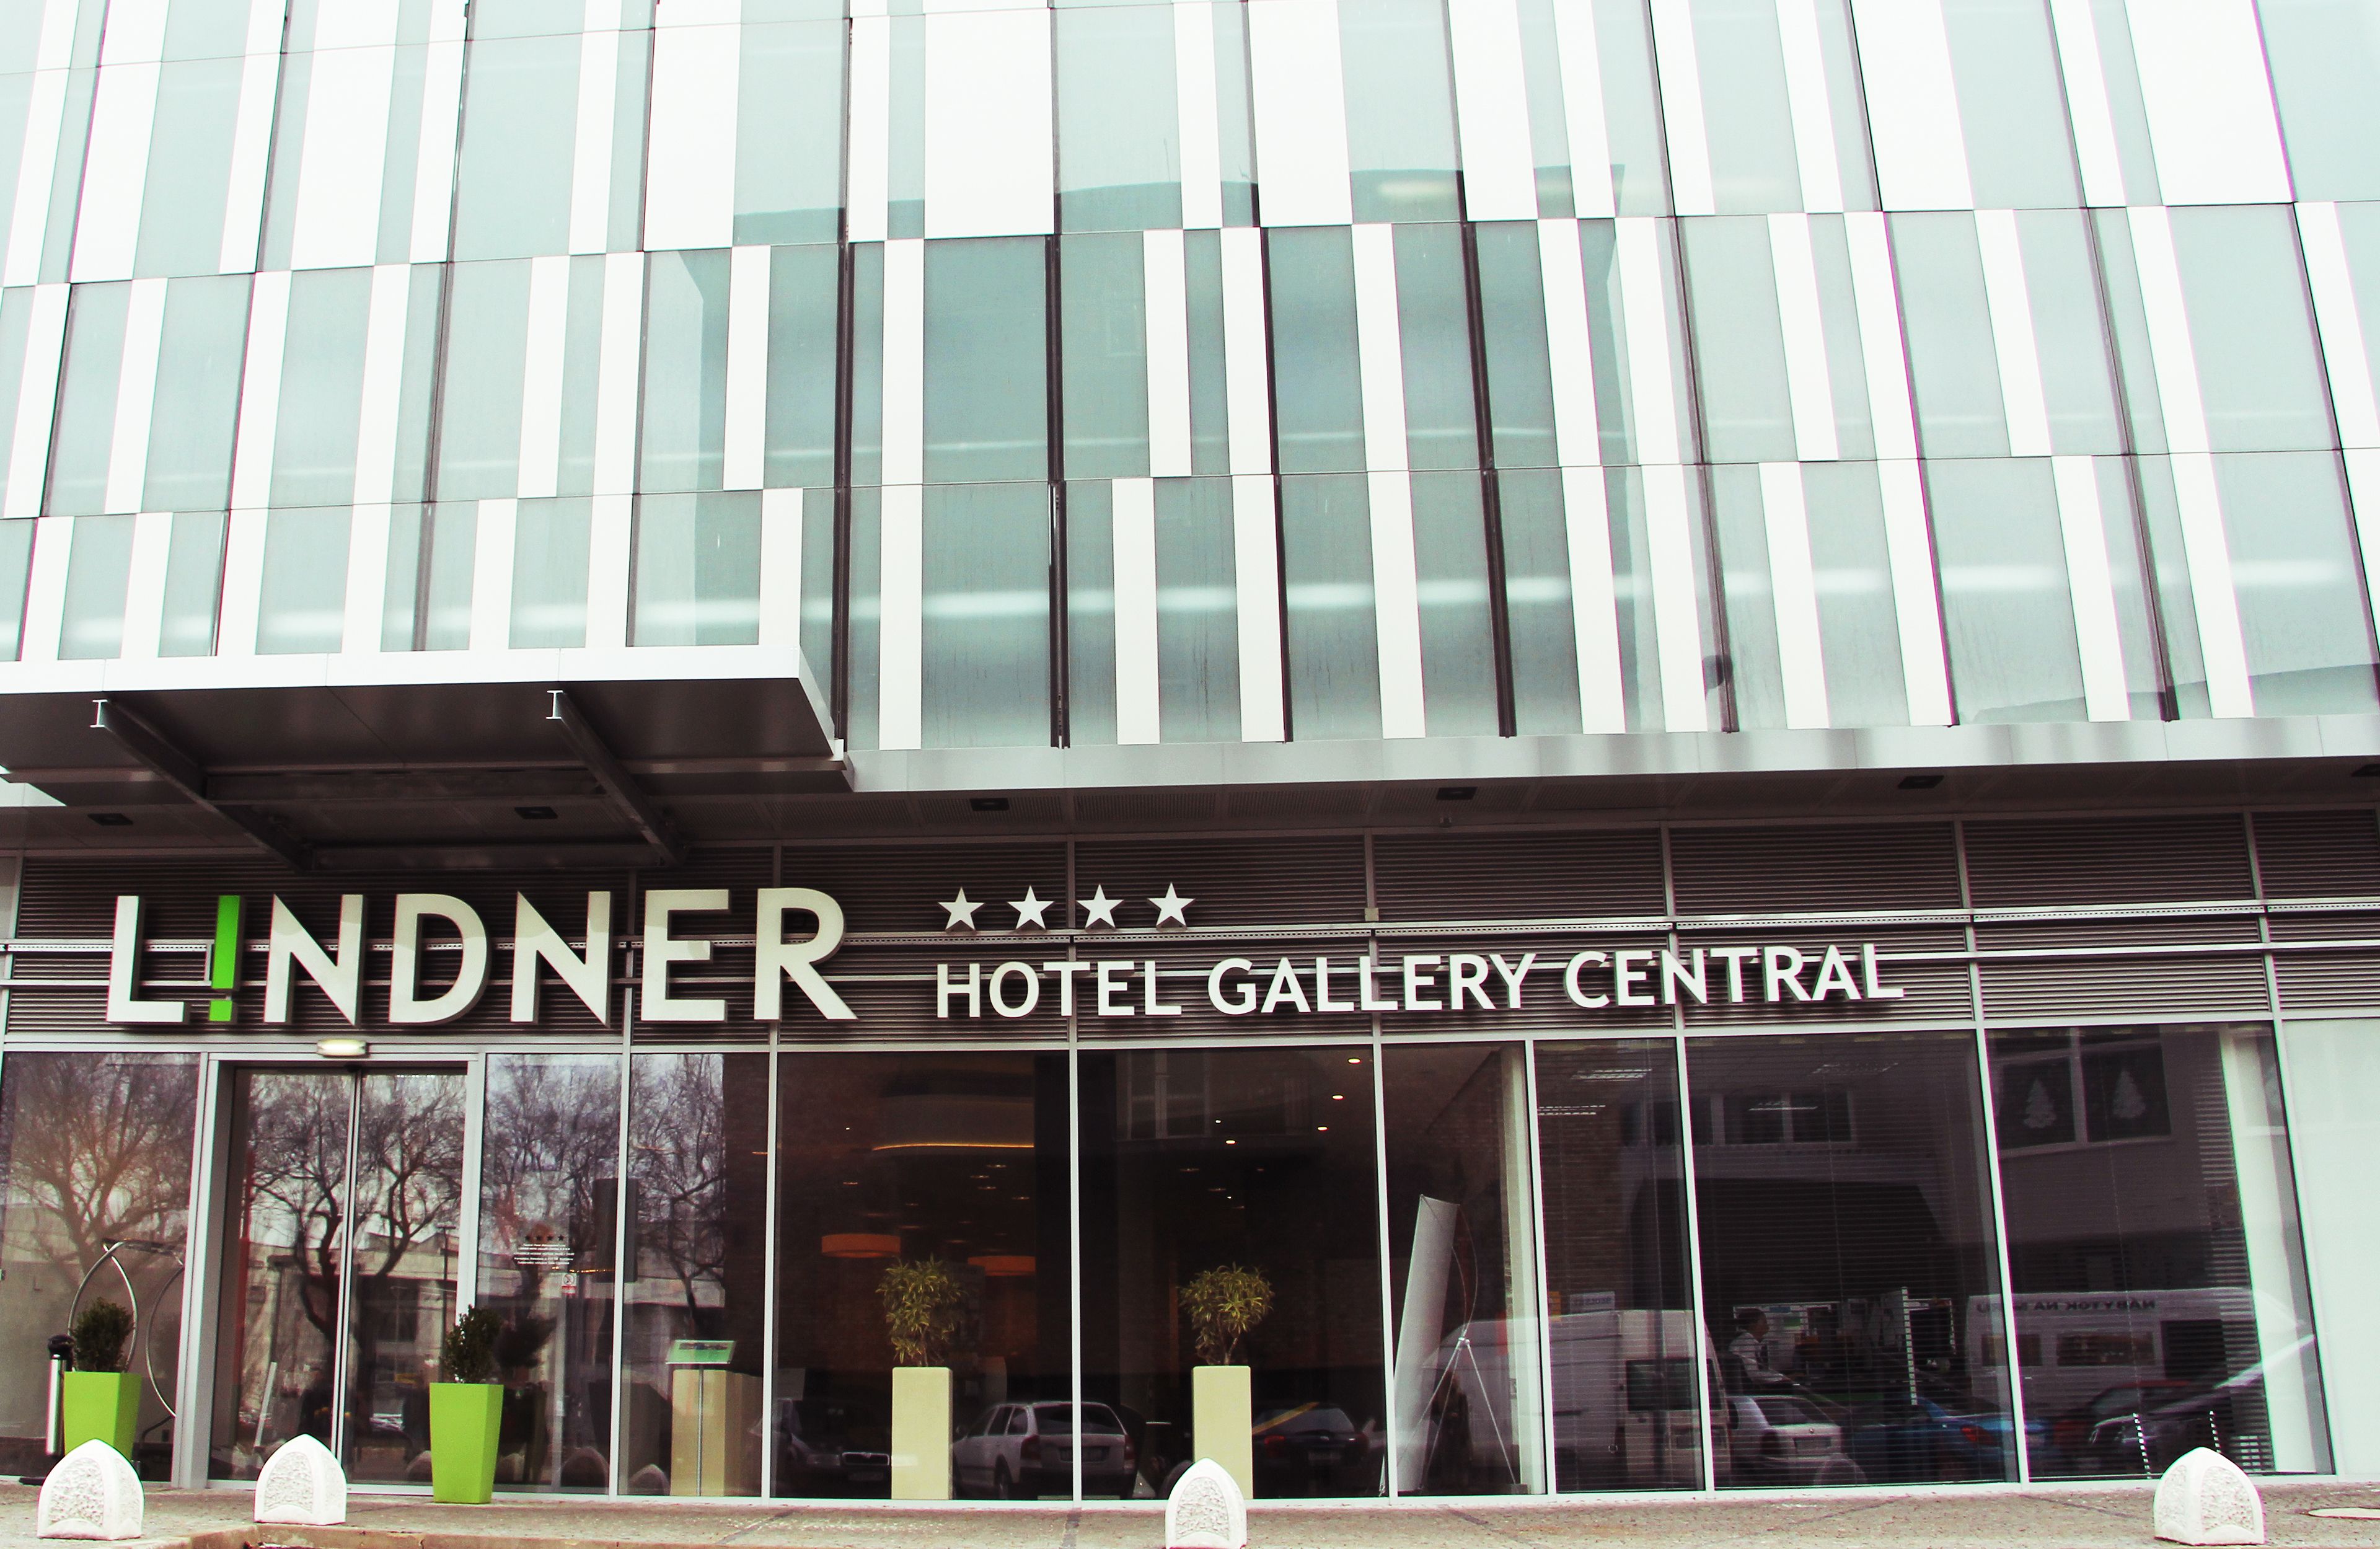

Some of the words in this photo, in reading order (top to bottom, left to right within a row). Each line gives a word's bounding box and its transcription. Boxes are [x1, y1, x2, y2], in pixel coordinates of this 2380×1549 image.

[937, 961, 1182, 1018] HOTEL
[1207, 953, 1536, 1015] GALLERY
[1563, 943, 1905, 1008] CENTRAL
